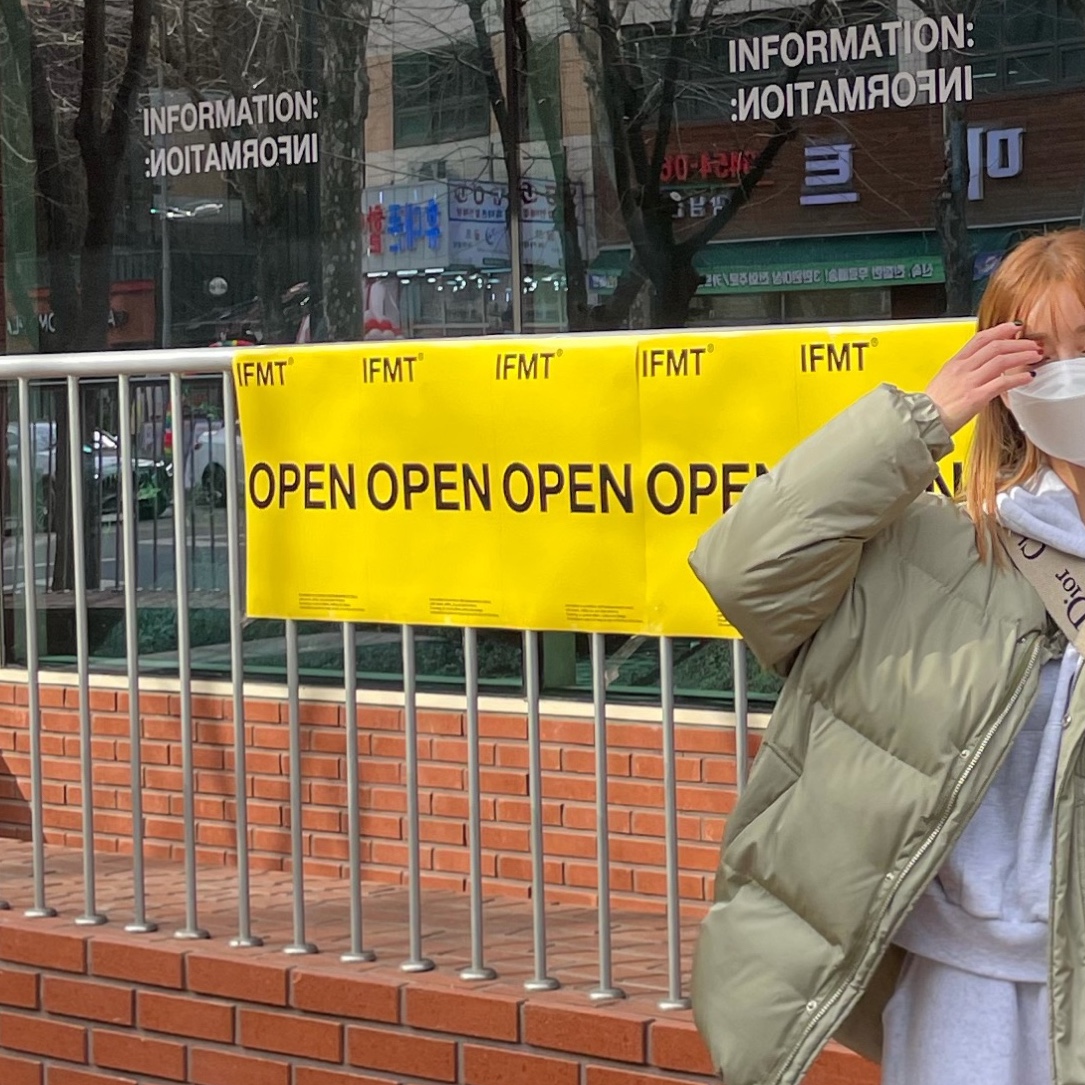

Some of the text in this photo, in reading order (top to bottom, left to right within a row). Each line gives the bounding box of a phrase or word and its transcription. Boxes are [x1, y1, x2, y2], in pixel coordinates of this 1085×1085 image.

[727, 14, 975, 73] INFORMATION:
[143, 90, 319, 137] INFORMATION:
[248, 462, 356, 509] OPEN
[367, 462, 492, 512] OPEN
[502, 462, 635, 515] OPEN
[646, 462, 770, 516] OPE
